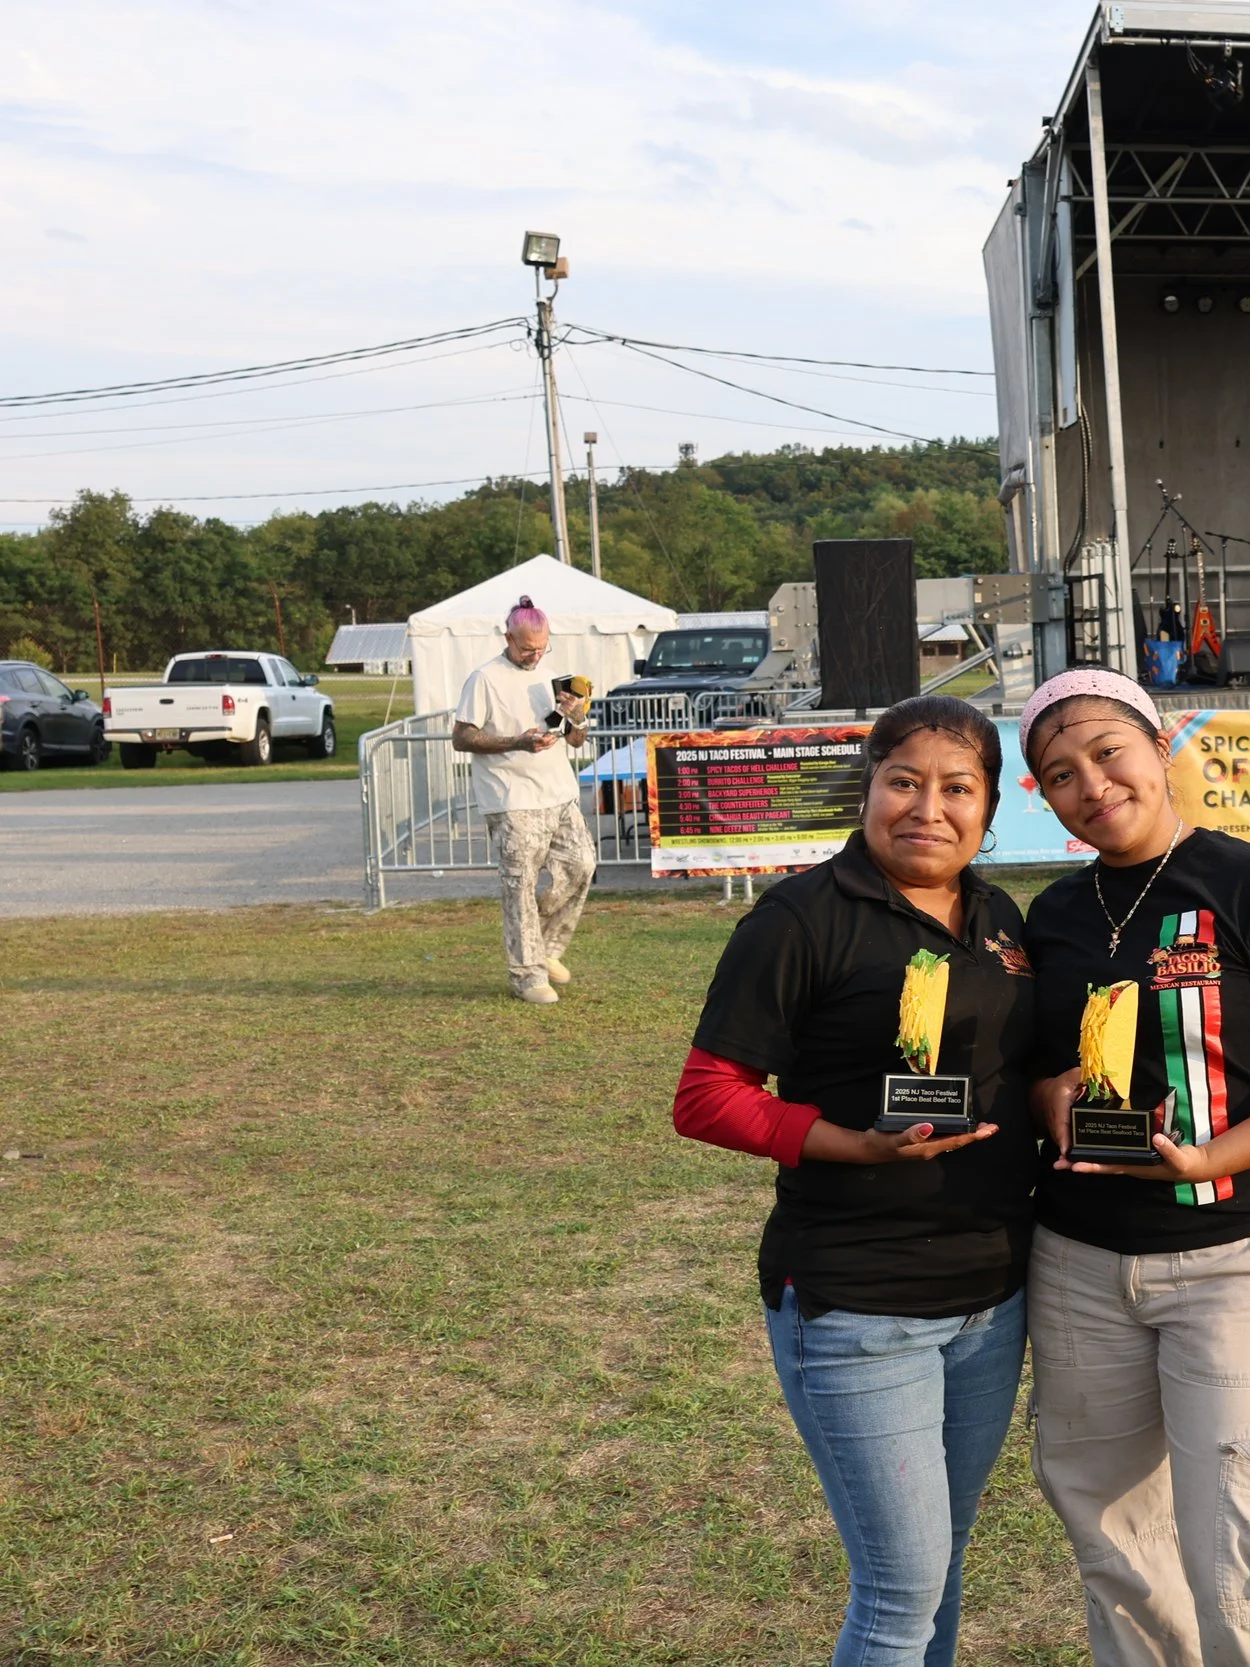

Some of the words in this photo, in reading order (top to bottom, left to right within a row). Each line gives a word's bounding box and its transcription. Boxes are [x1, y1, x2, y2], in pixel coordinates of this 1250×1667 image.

[676, 750, 697, 762] 2025
[698, 750, 708, 761] NJ
[709, 749, 730, 761] TACO
[730, 748, 767, 761] FESTIVAL
[773, 747, 795, 759] MAIN
[795, 745, 820, 758] STAGE
[821, 744, 862, 757] SCHEDULE
[677, 767, 690, 775] 1:00
[706, 766, 723, 775] SPICY
[723, 765, 742, 774] TACOS
[742, 764, 750, 773] OF
[750, 764, 765, 773] HELL
[765, 763, 798, 772] CHALLENGE
[1202, 757, 1250, 784] OF
[677, 779, 691, 787] 2:00
[732, 776, 764, 785] CHALLENGE
[707, 789, 737, 799] BACKYARD
[738, 787, 778, 798] SUPERHEROES
[708, 802, 719, 811] THE
[720, 799, 768, 810] COUNTERFEITERS
[741, 812, 763, 821] BEAUTY
[764, 810, 791, 820] PAGEANT
[680, 826, 694, 834] 6:45
[709, 825, 722, 834] NINE
[742, 824, 755, 833] NITE
[1167, 953, 1208, 965] TACOS
[1157, 961, 1221, 977] BASILIO
[1149, 982, 1180, 991] MEXICAN
[1180, 980, 1221, 988] RESTAURANT
